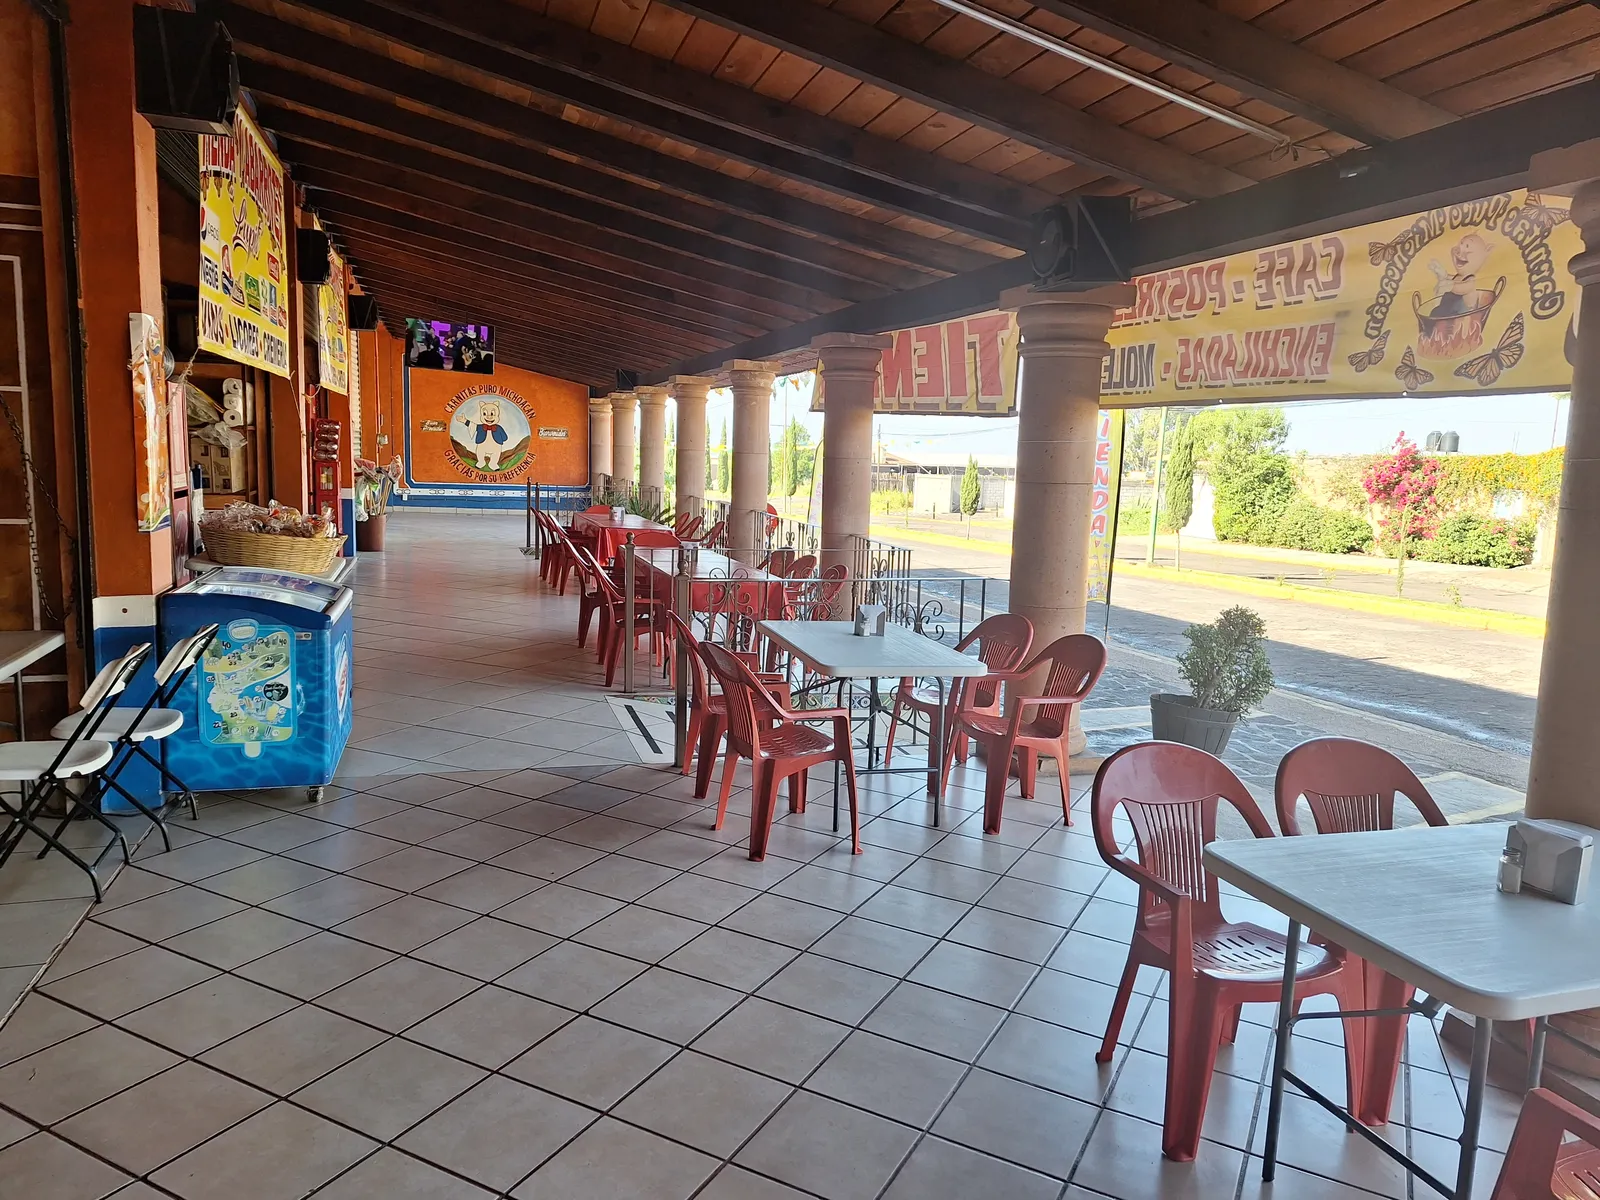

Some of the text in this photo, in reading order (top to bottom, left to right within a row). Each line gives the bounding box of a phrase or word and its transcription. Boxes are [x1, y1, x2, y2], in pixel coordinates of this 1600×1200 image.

[444, 384, 537, 420] CARNITAS PURO MICHOACAN
[444, 449, 537, 483] GRACIAS POR SU PREFERENCIA
[1091, 410, 1111, 537] IENDA
